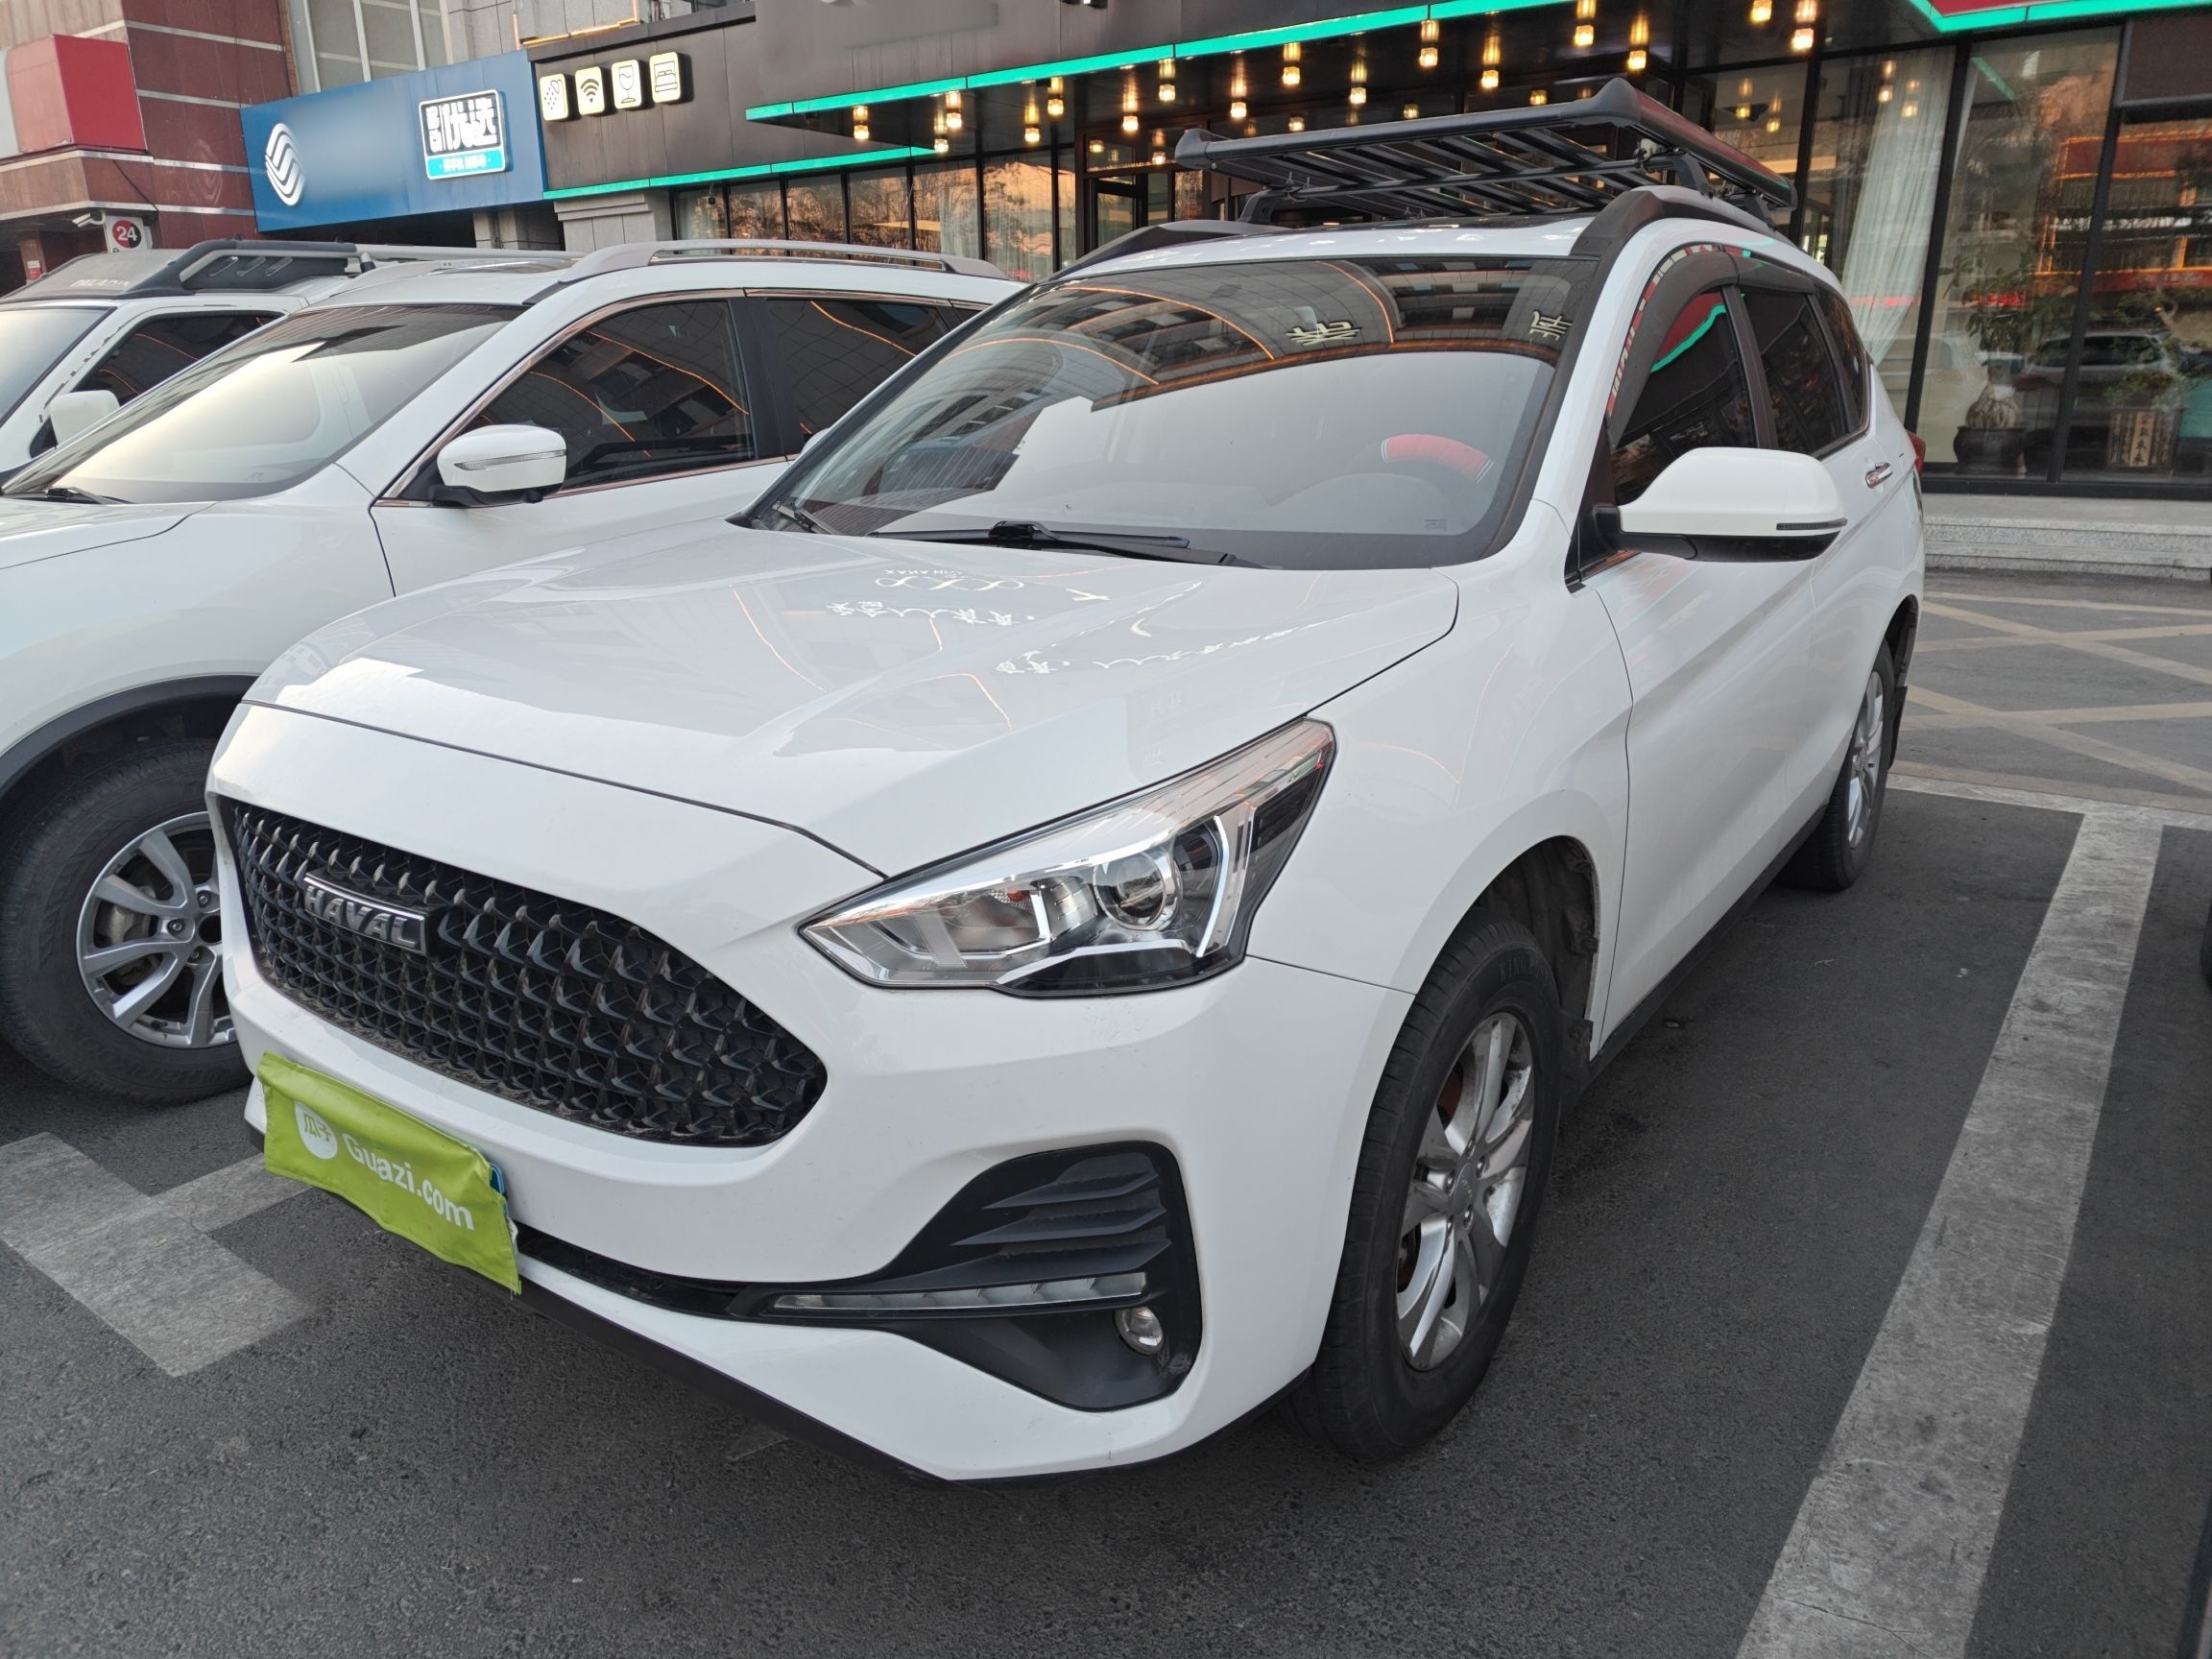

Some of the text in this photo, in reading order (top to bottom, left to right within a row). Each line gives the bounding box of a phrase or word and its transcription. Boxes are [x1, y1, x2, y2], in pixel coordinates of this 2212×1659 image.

[116, 226, 138, 242] 24
[304, 885, 417, 949] HAVAL
[342, 1132, 475, 1231] Guazi.com
